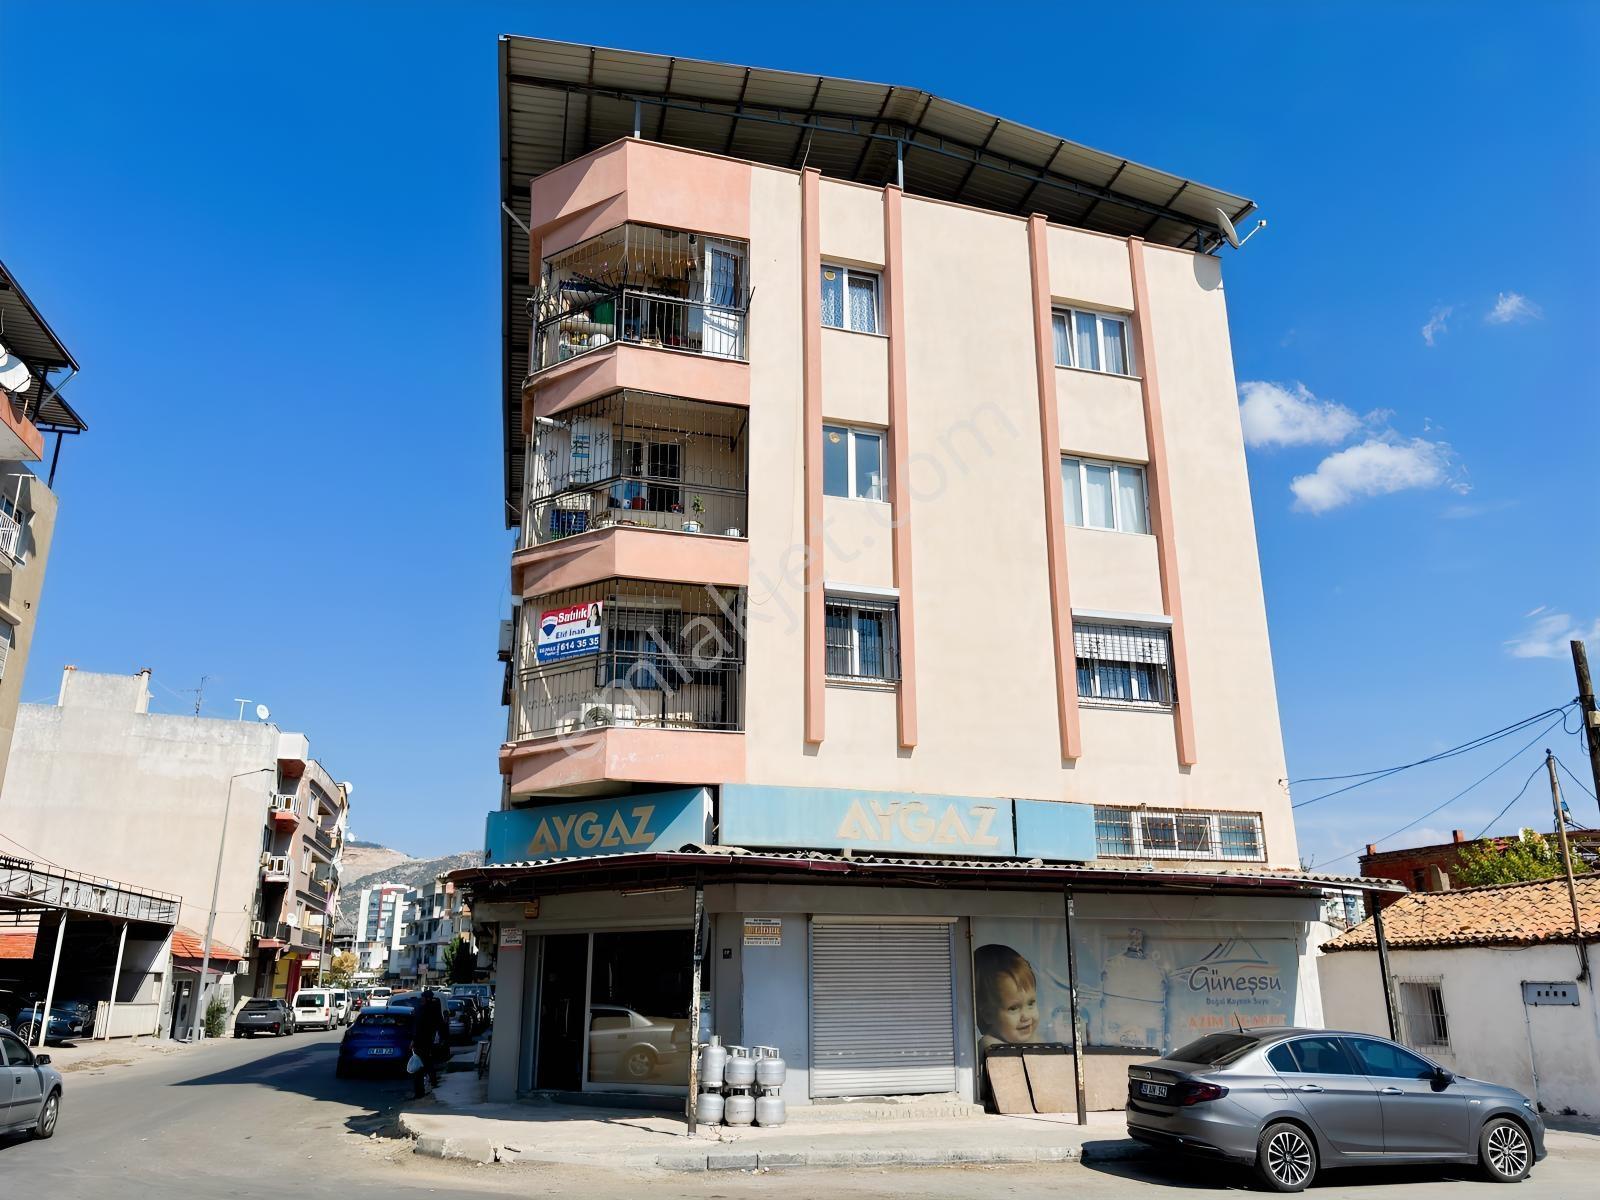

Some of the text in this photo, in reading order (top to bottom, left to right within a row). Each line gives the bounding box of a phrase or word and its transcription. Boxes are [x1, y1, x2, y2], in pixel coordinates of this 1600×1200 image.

[561, 641, 575, 651] 614
[577, 639, 587, 648] 35
[589, 637, 599, 646] 35
[527, 805, 656, 855] AYGAZ
[835, 798, 999, 845] AYGAZ
[1189, 966, 1281, 995] Güneşsu
